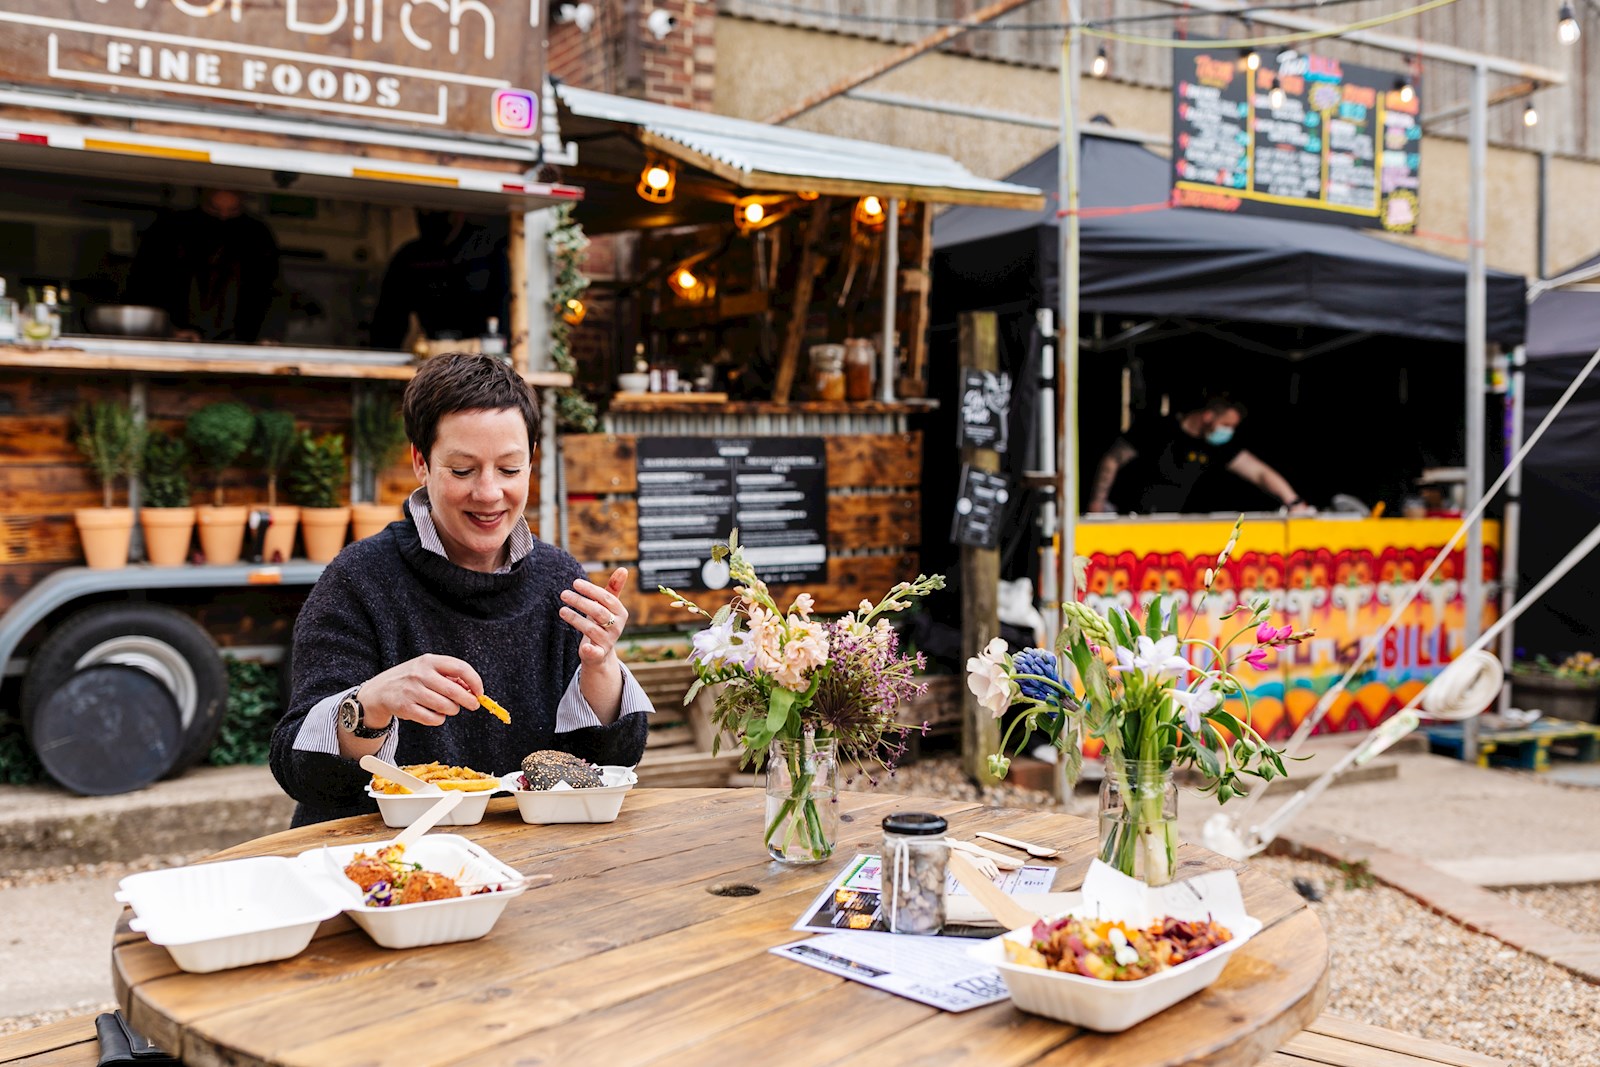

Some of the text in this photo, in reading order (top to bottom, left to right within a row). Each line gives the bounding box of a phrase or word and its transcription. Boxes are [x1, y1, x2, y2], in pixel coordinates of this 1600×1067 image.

[106, 41, 401, 107] FINE FOODS
[1384, 621, 1452, 667] BILL
